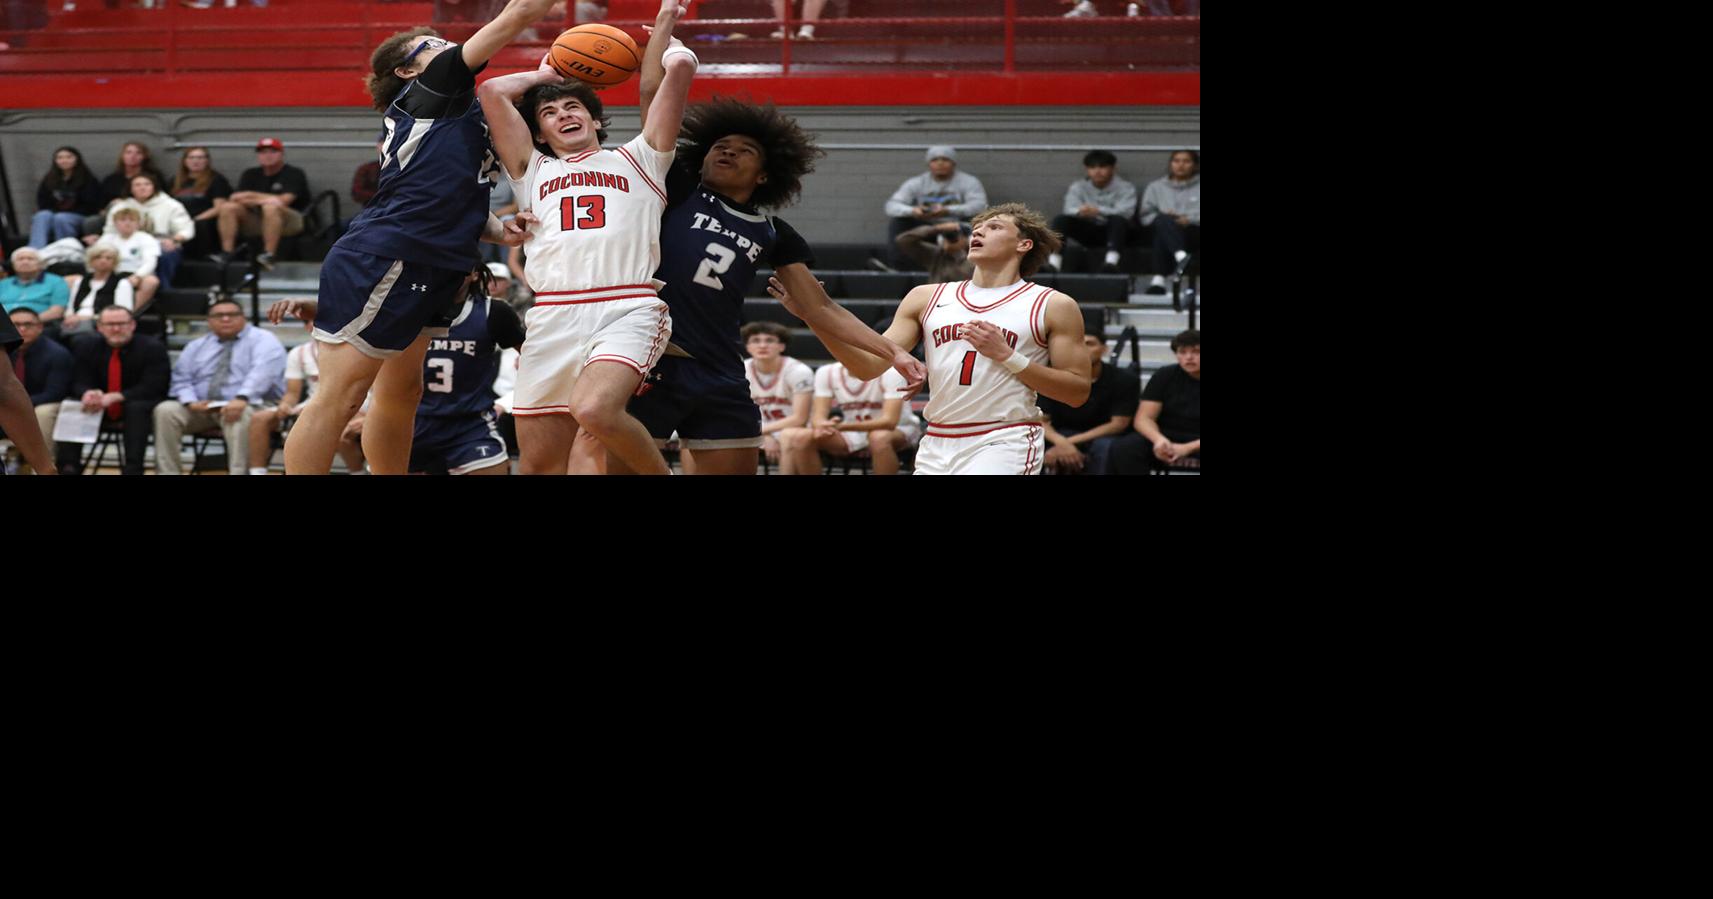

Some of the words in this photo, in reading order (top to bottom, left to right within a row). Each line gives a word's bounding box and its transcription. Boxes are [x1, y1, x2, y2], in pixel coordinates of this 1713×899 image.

[569, 61, 605, 77] EVO
[539, 171, 630, 201] COCONINO
[559, 194, 606, 231] 13
[692, 242, 736, 291] 2
[932, 323, 1019, 350] COCO
[427, 358, 454, 393] 3
[959, 350, 977, 386] 1
[476, 445, 490, 457] T
